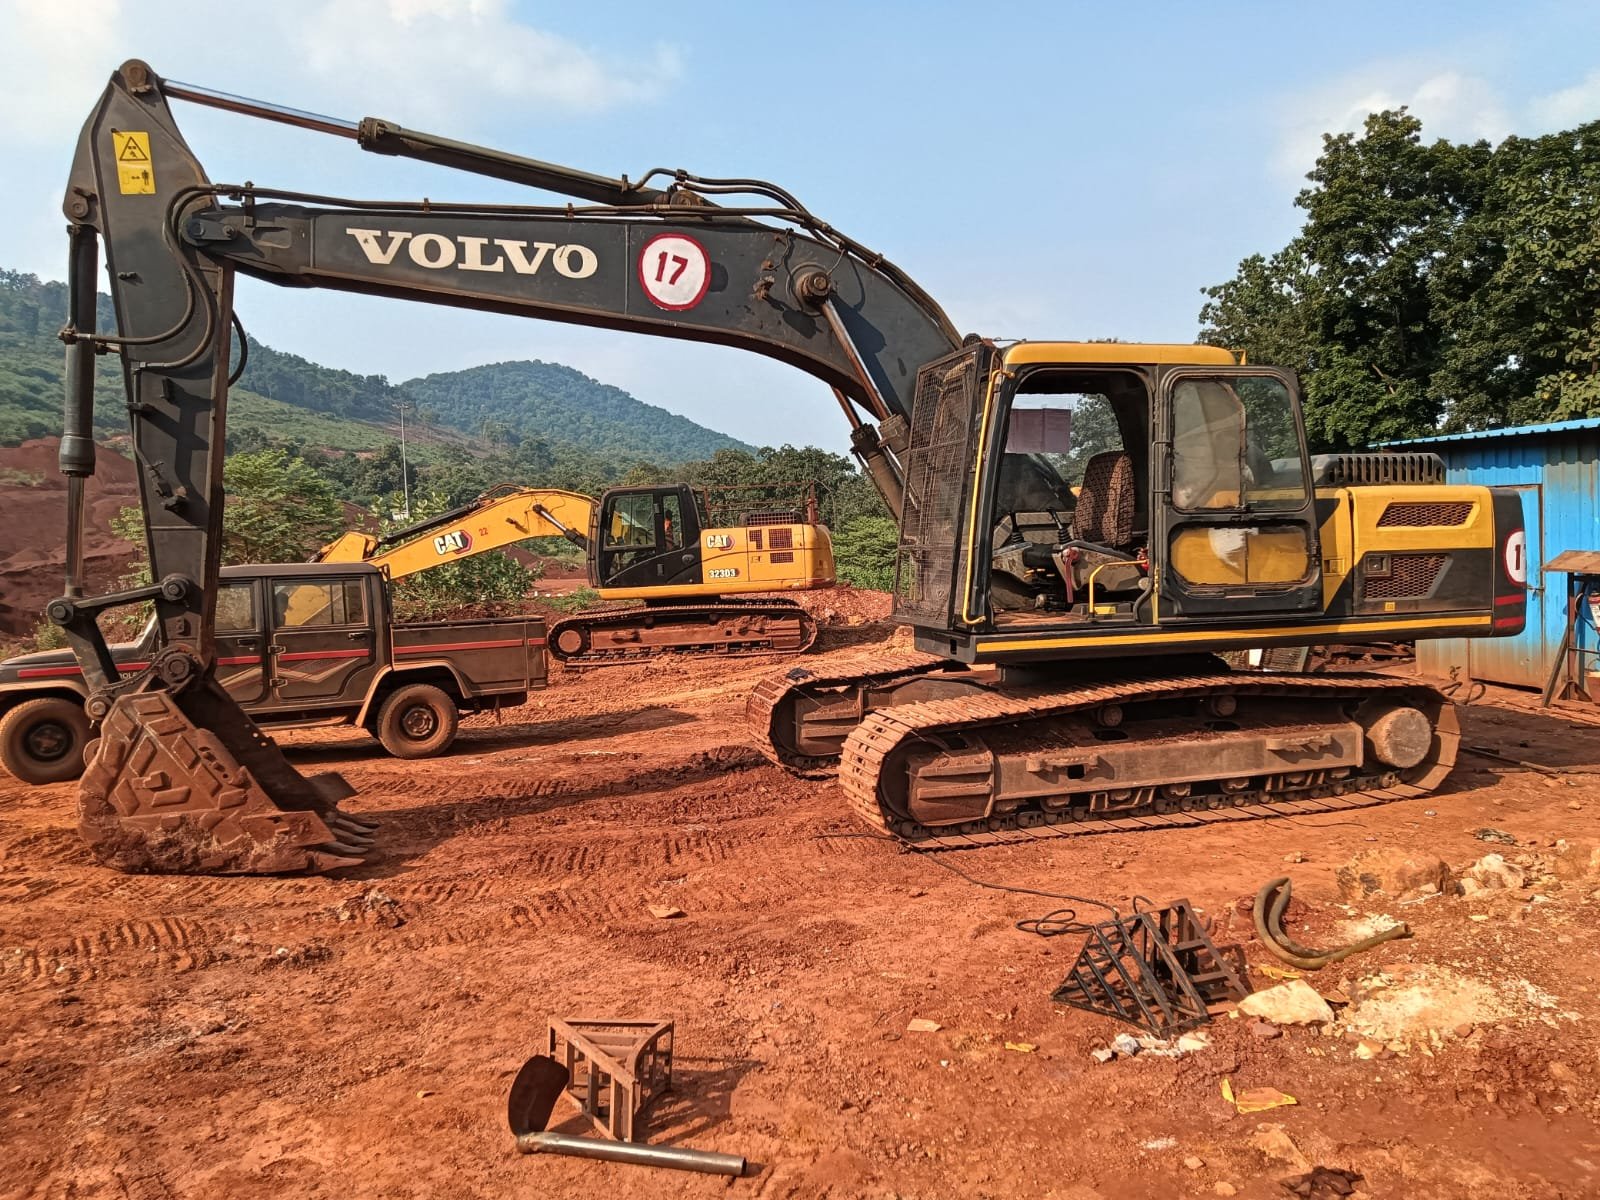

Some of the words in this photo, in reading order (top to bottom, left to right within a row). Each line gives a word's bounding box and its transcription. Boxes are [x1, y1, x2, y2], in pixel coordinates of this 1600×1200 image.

[346, 228, 598, 278] VOLVO
[654, 251, 689, 286] 17
[433, 531, 463, 555] CAT
[479, 527, 489, 536] 22
[706, 535, 729, 549] CAT
[1515, 544, 1527, 571] 1
